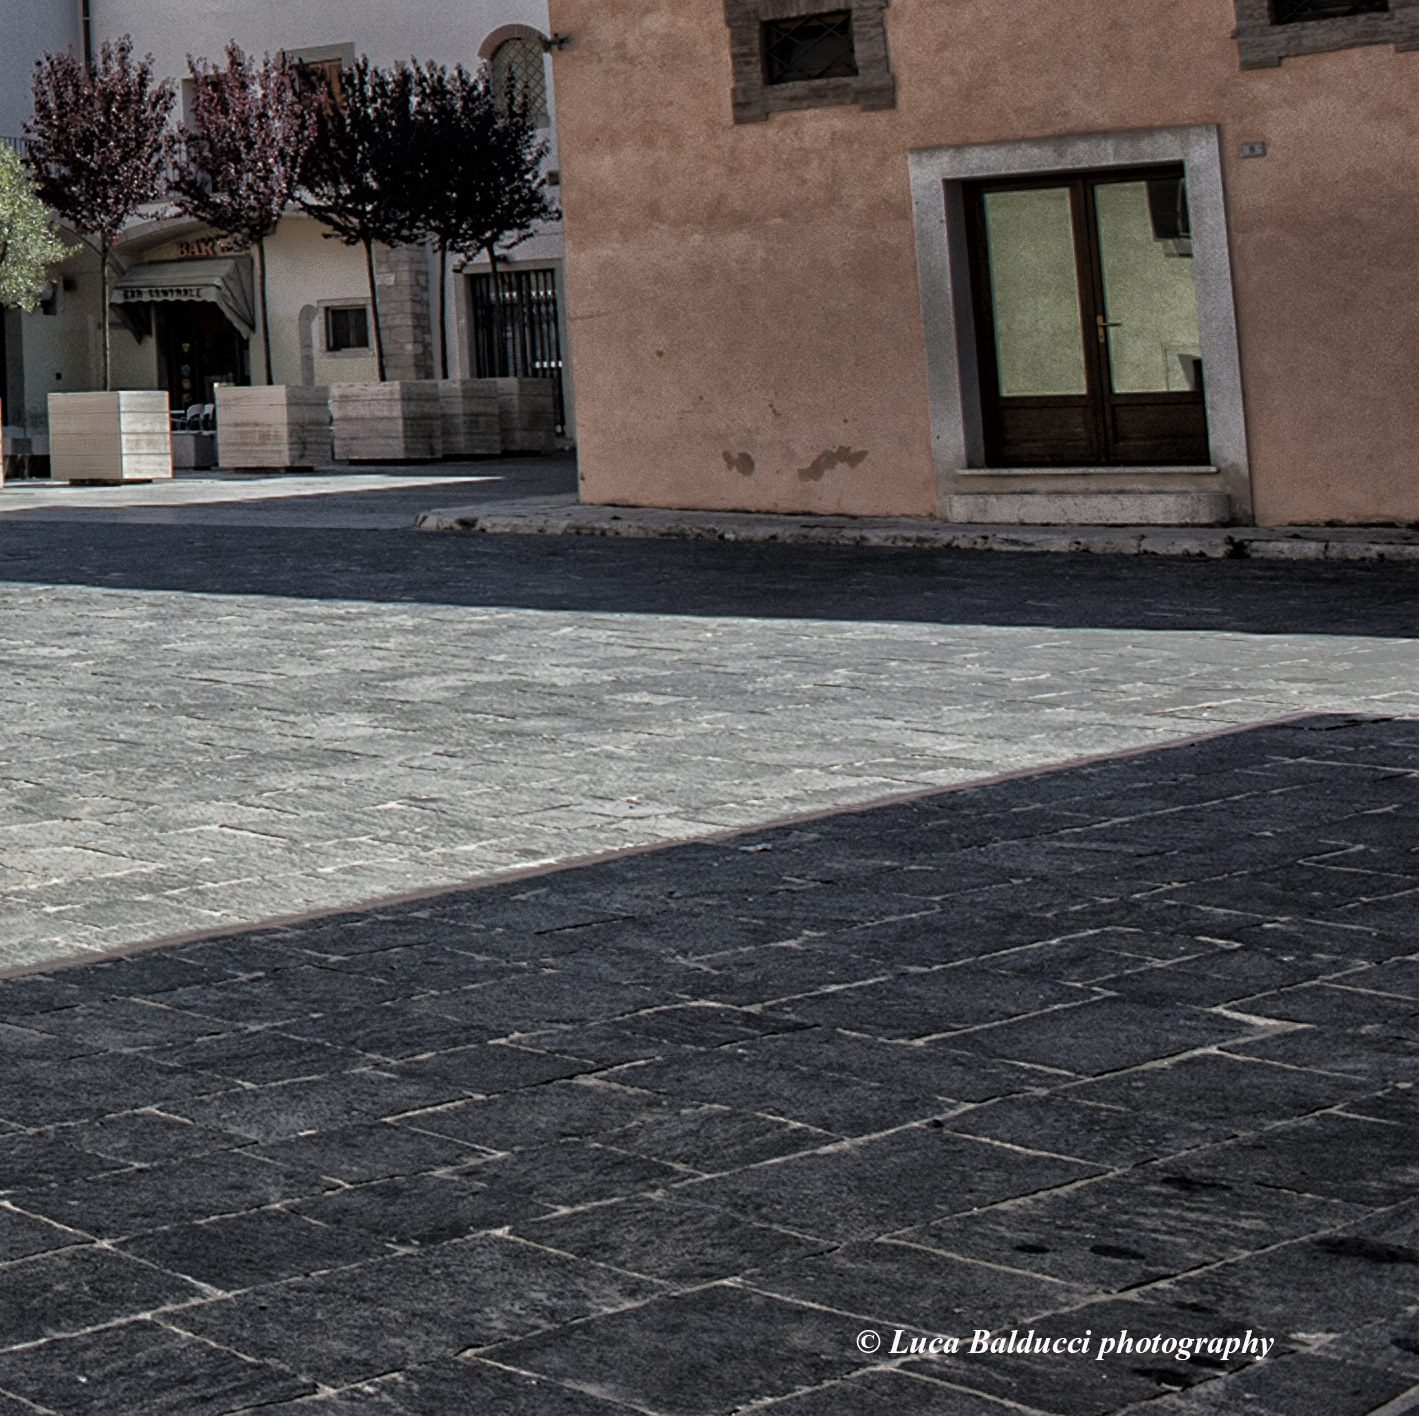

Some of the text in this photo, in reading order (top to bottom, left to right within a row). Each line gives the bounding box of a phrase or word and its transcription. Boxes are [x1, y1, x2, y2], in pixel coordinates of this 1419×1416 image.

[178, 241, 214, 257] BAR
[123, 287, 202, 299] BAR CENTRALE
